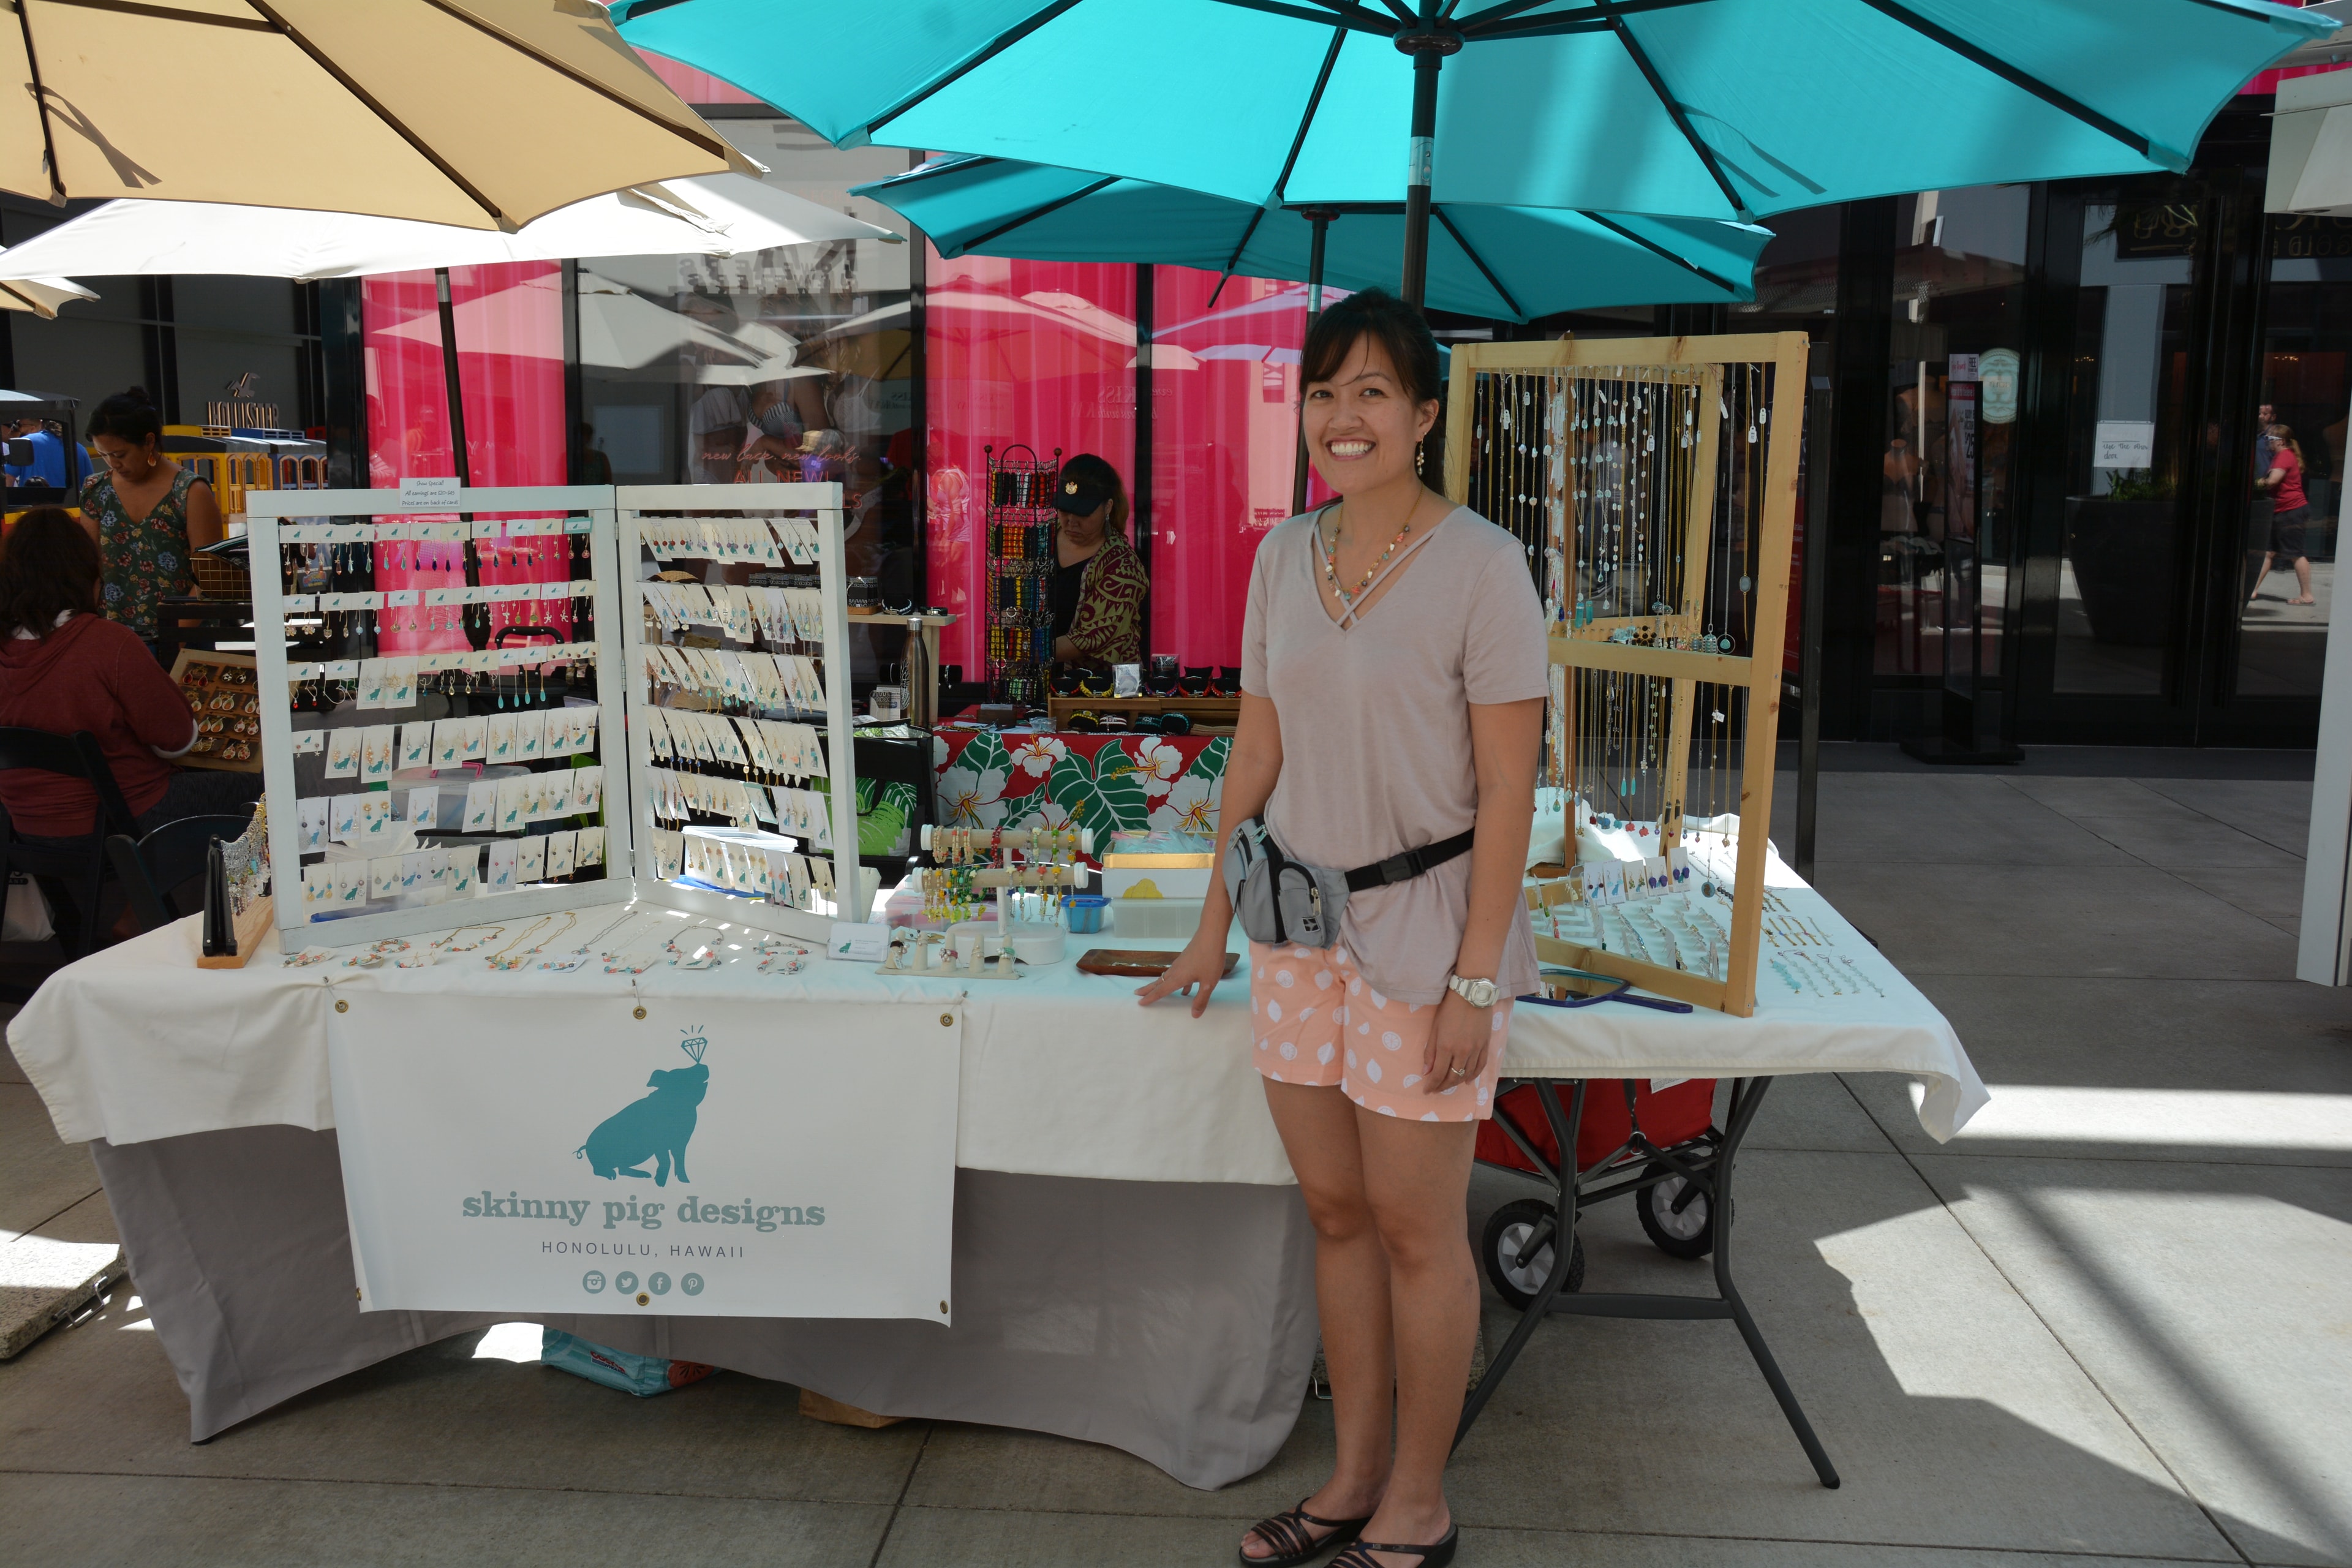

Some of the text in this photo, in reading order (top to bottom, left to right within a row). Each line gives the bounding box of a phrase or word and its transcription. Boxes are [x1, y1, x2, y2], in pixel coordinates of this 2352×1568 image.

[702, 451, 731, 461] new
[782, 451, 813, 461] new
[462, 1190, 825, 1232] skinny pig designs
[542, 1241, 744, 1257] HONOLULU, HAWAII
